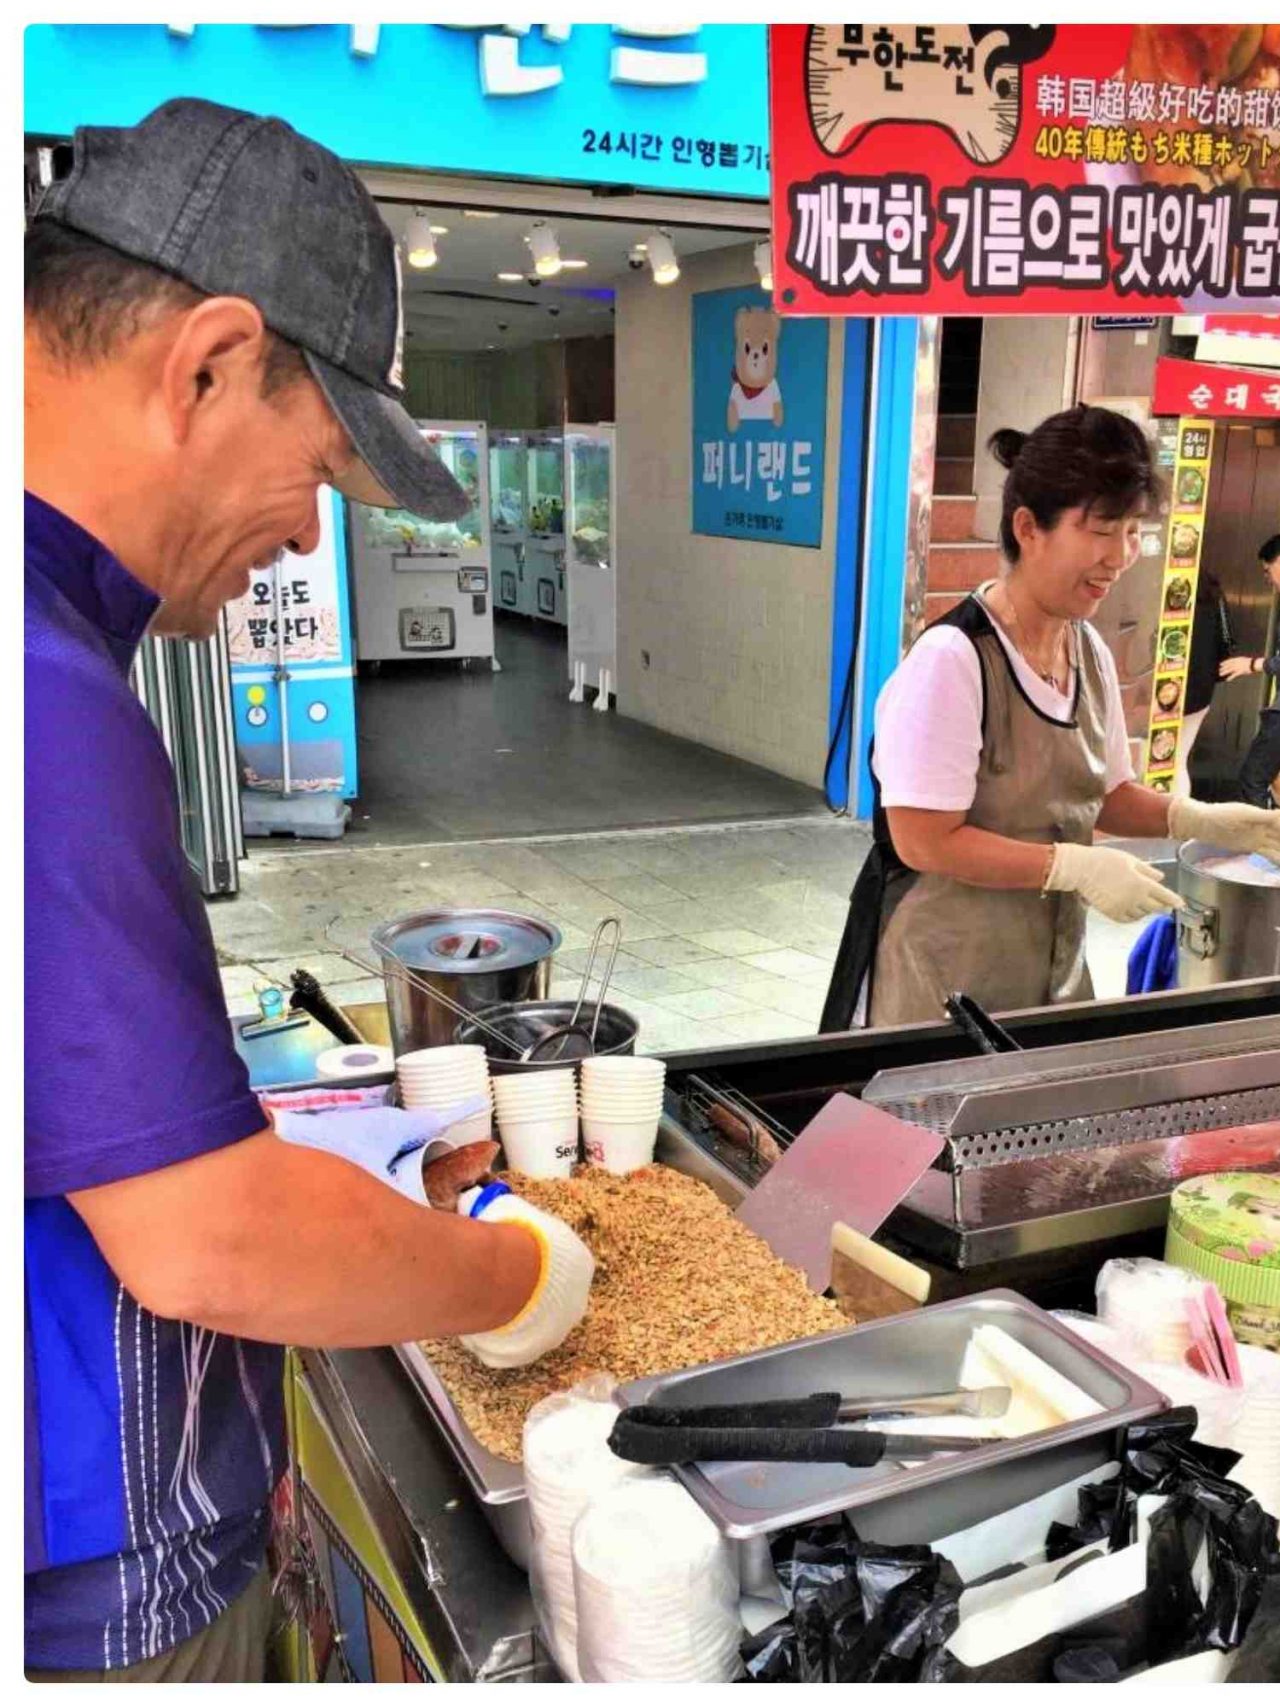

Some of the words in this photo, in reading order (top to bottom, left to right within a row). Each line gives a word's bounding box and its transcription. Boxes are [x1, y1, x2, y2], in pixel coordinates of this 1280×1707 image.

[837, 25, 975, 96] 무한도전
[582, 129, 664, 161] 24시간
[671, 137, 770, 171] 인형뽑기
[794, 183, 928, 286] 깨끗한
[943, 187, 1103, 287] 기름으로
[1119, 192, 1232, 288] 맛있게
[702, 440, 812, 502] 퍼니랜드
